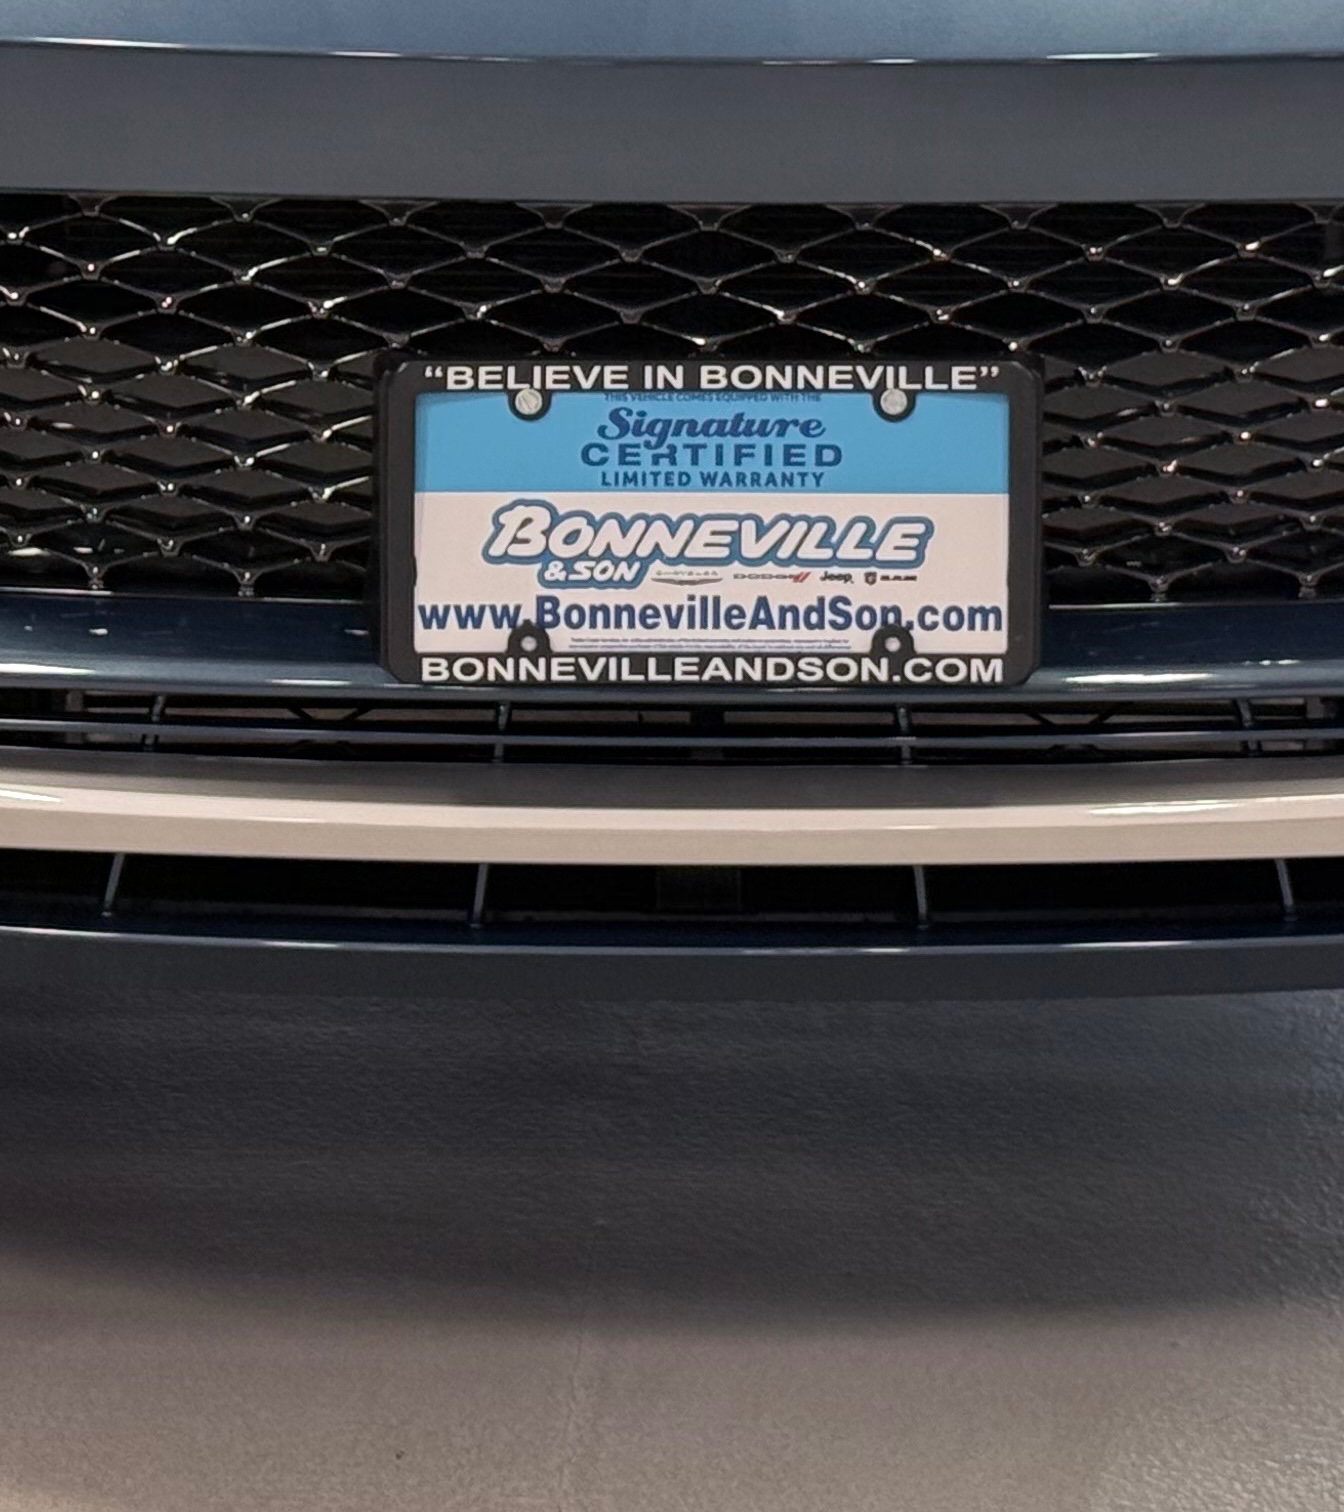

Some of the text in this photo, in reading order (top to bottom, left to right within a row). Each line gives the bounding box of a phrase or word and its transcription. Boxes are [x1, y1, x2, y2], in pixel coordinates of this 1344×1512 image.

[644, 365, 684, 390] IN
[597, 407, 826, 450] Signature
[581, 442, 843, 467] CERTIFIED
[601, 471, 825, 488] LIMITED WARRANTY
[486, 502, 924, 561] BONNEVILLE
[820, 568, 850, 584] Jeep
[421, 656, 1003, 683] BONNEVILLEANDSON.COM
